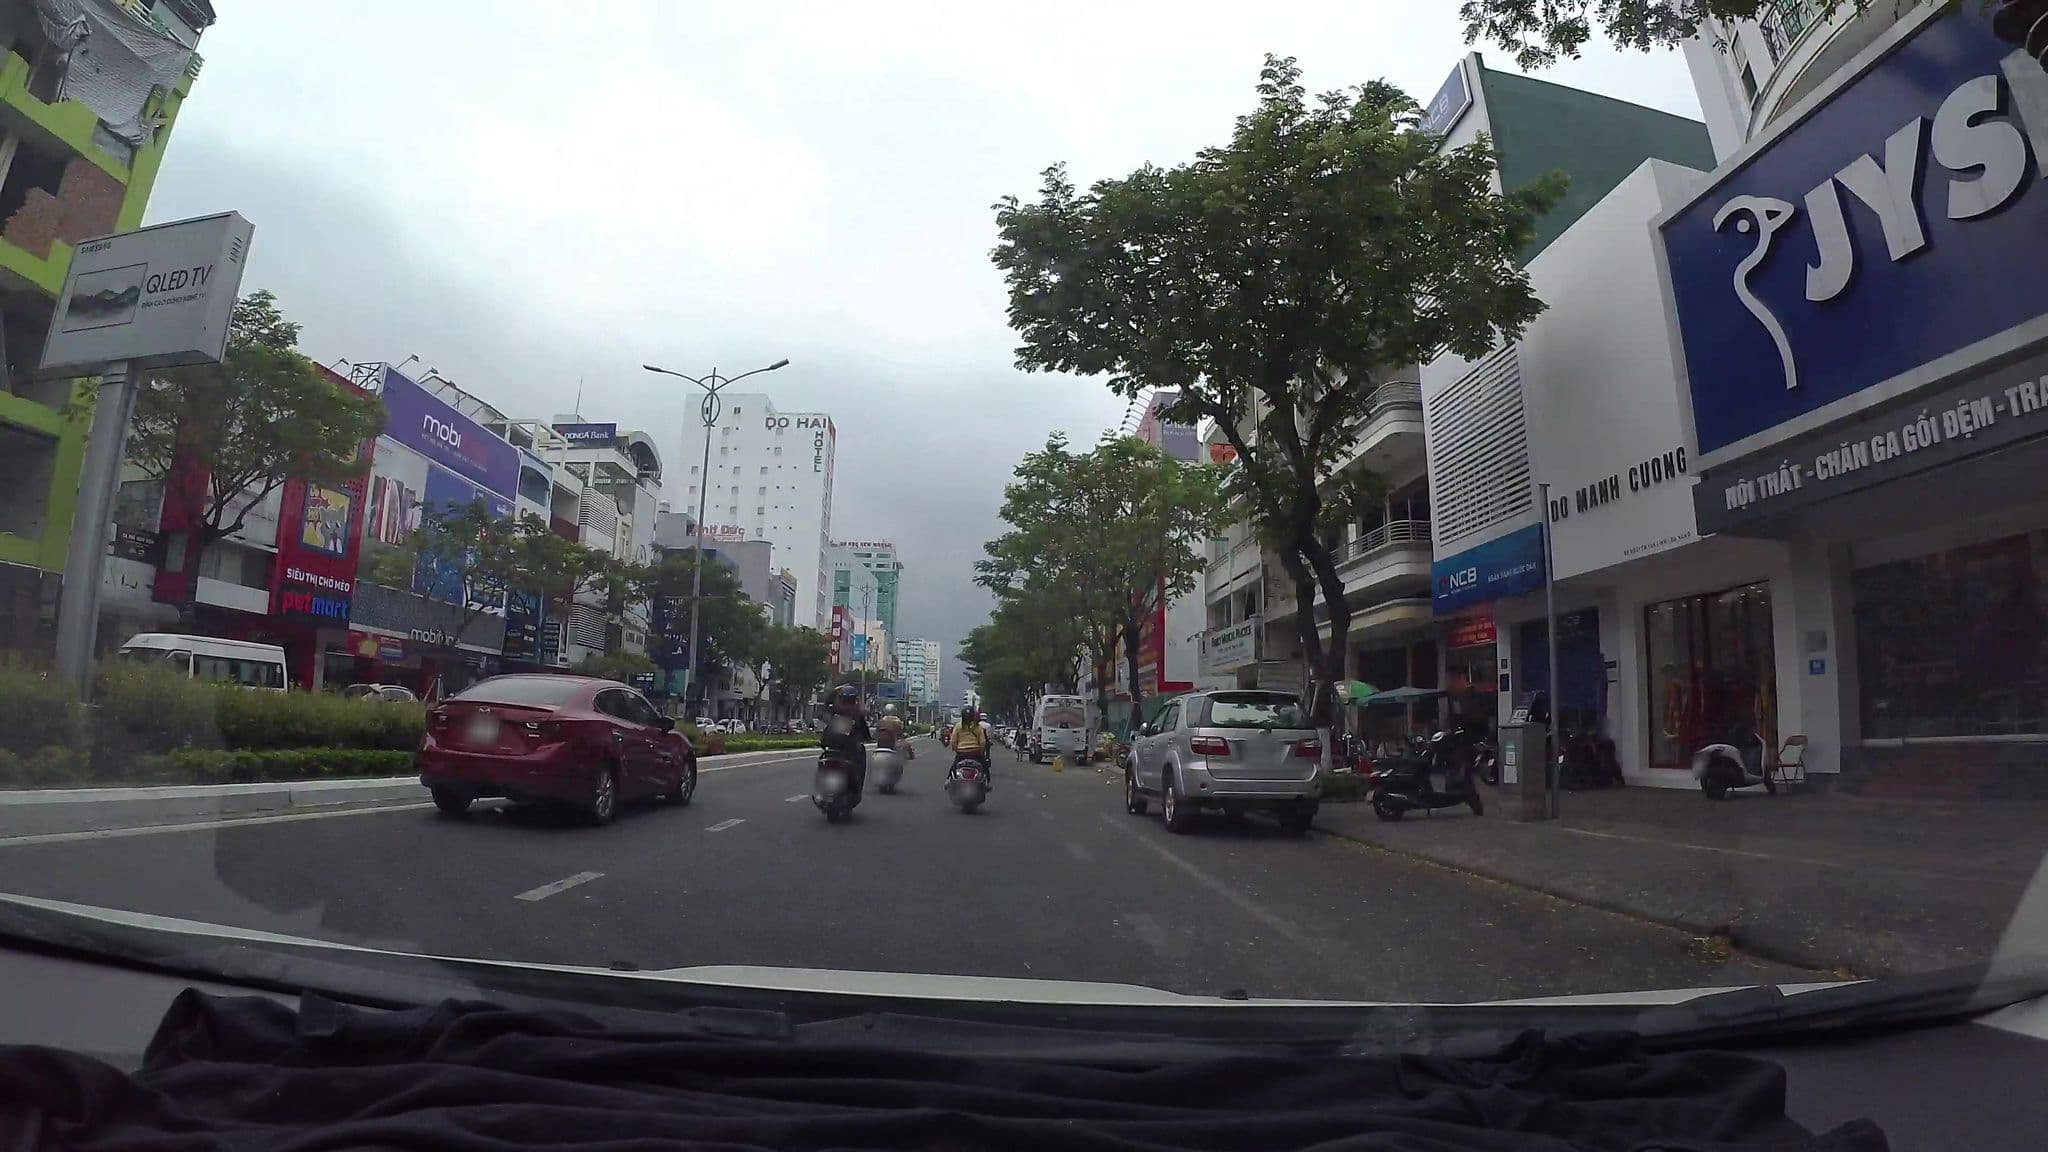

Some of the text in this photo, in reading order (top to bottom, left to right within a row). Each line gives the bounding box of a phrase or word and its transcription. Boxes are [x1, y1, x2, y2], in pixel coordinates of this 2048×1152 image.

[146, 264, 213, 294] QLED TV
[796, 417, 827, 429] HAI
[813, 431, 824, 472] HOTEL
[1725, 478, 1756, 510] NỘI
[1757, 459, 1803, 499] THẤT
[1815, 441, 1870, 480] CHĂN
[1871, 431, 1901, 463] GA
[1902, 408, 1941, 452] GỐI
[1943, 396, 1995, 440] ĐỆM
[1576, 474, 1620, 513] MANH
[1628, 446, 1687, 492] CUONG
[286, 567, 305, 582] SIÊU
[305, 571, 318, 587] THỊ
[1450, 567, 1477, 589] NCB
